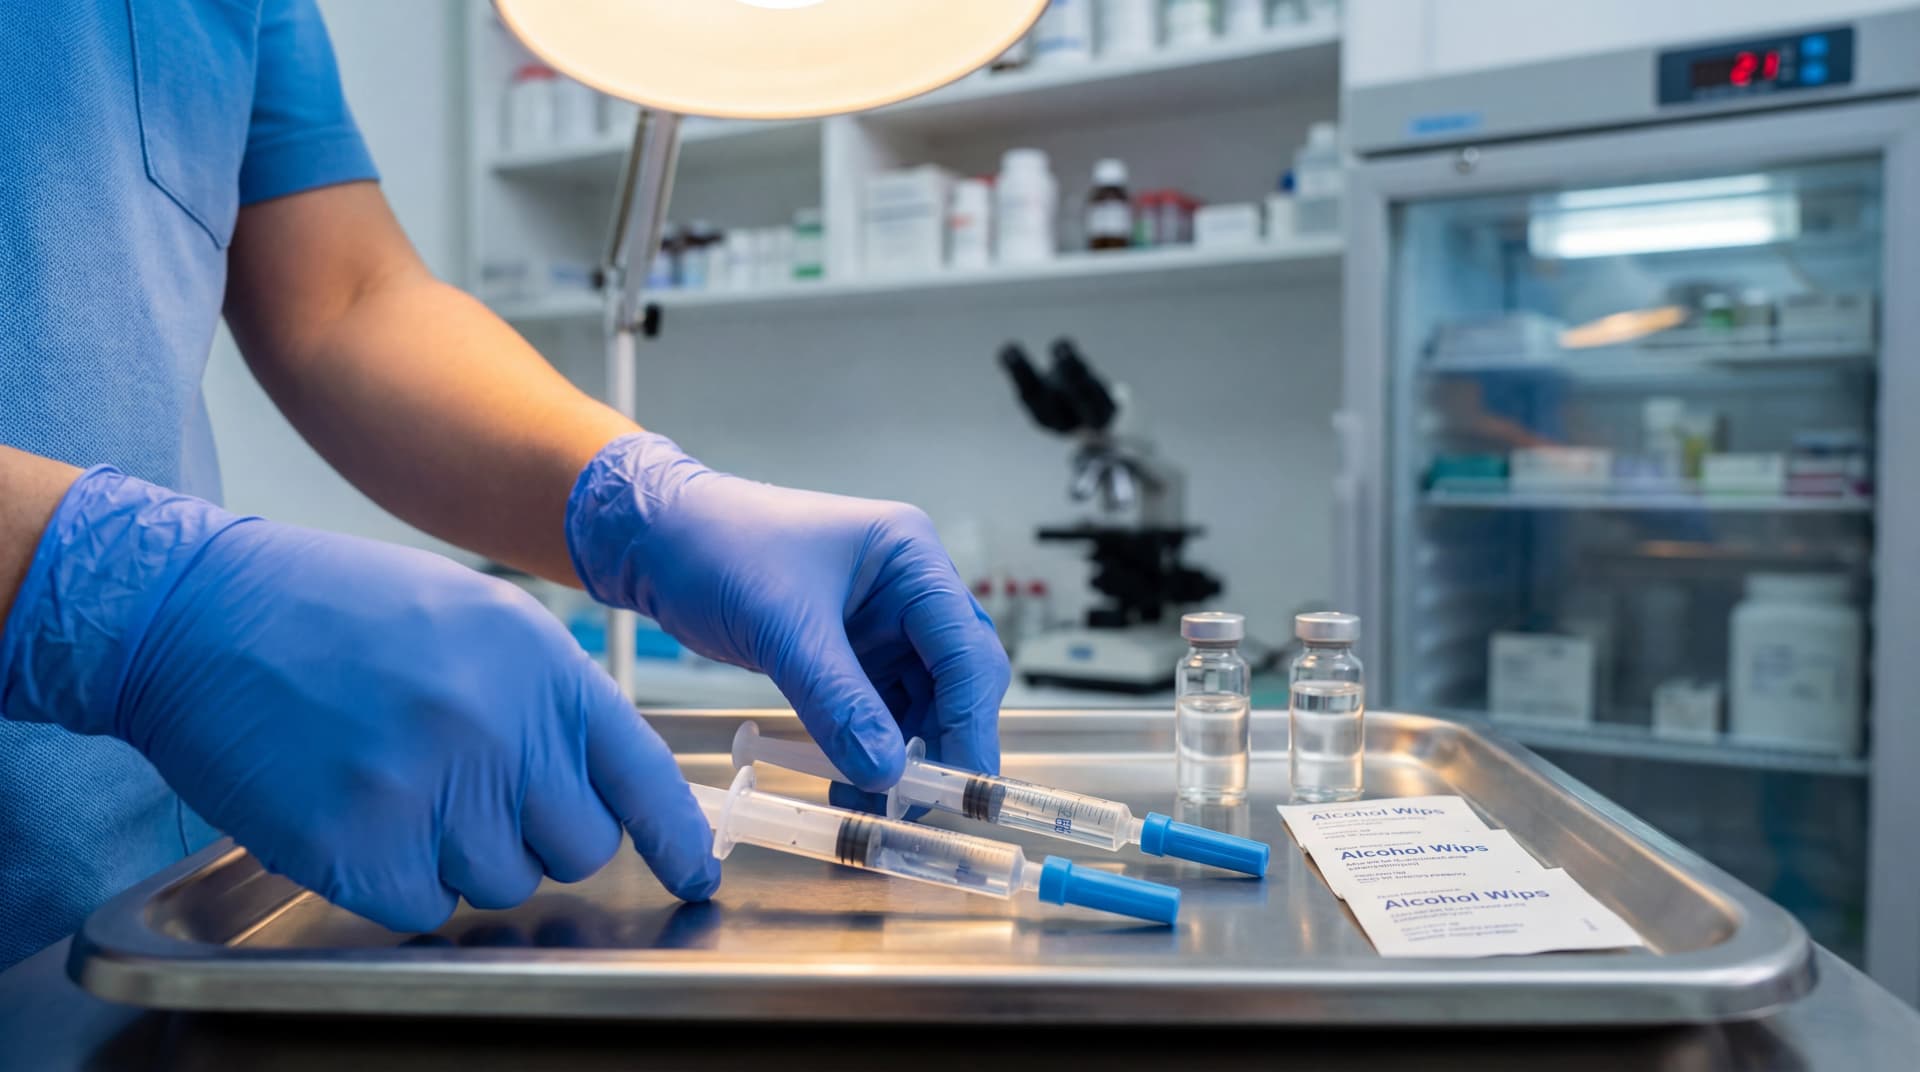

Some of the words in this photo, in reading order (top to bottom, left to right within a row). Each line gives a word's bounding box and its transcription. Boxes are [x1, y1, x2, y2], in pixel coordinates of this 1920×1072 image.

[1311, 808, 1388, 821] Alcohol
[1392, 806, 1445, 816] Wips
[1340, 846, 1426, 860] Alcohol
[1429, 843, 1489, 854] Wips
[1384, 892, 1480, 910] Alcohol
[1484, 889, 1550, 901] Wips
